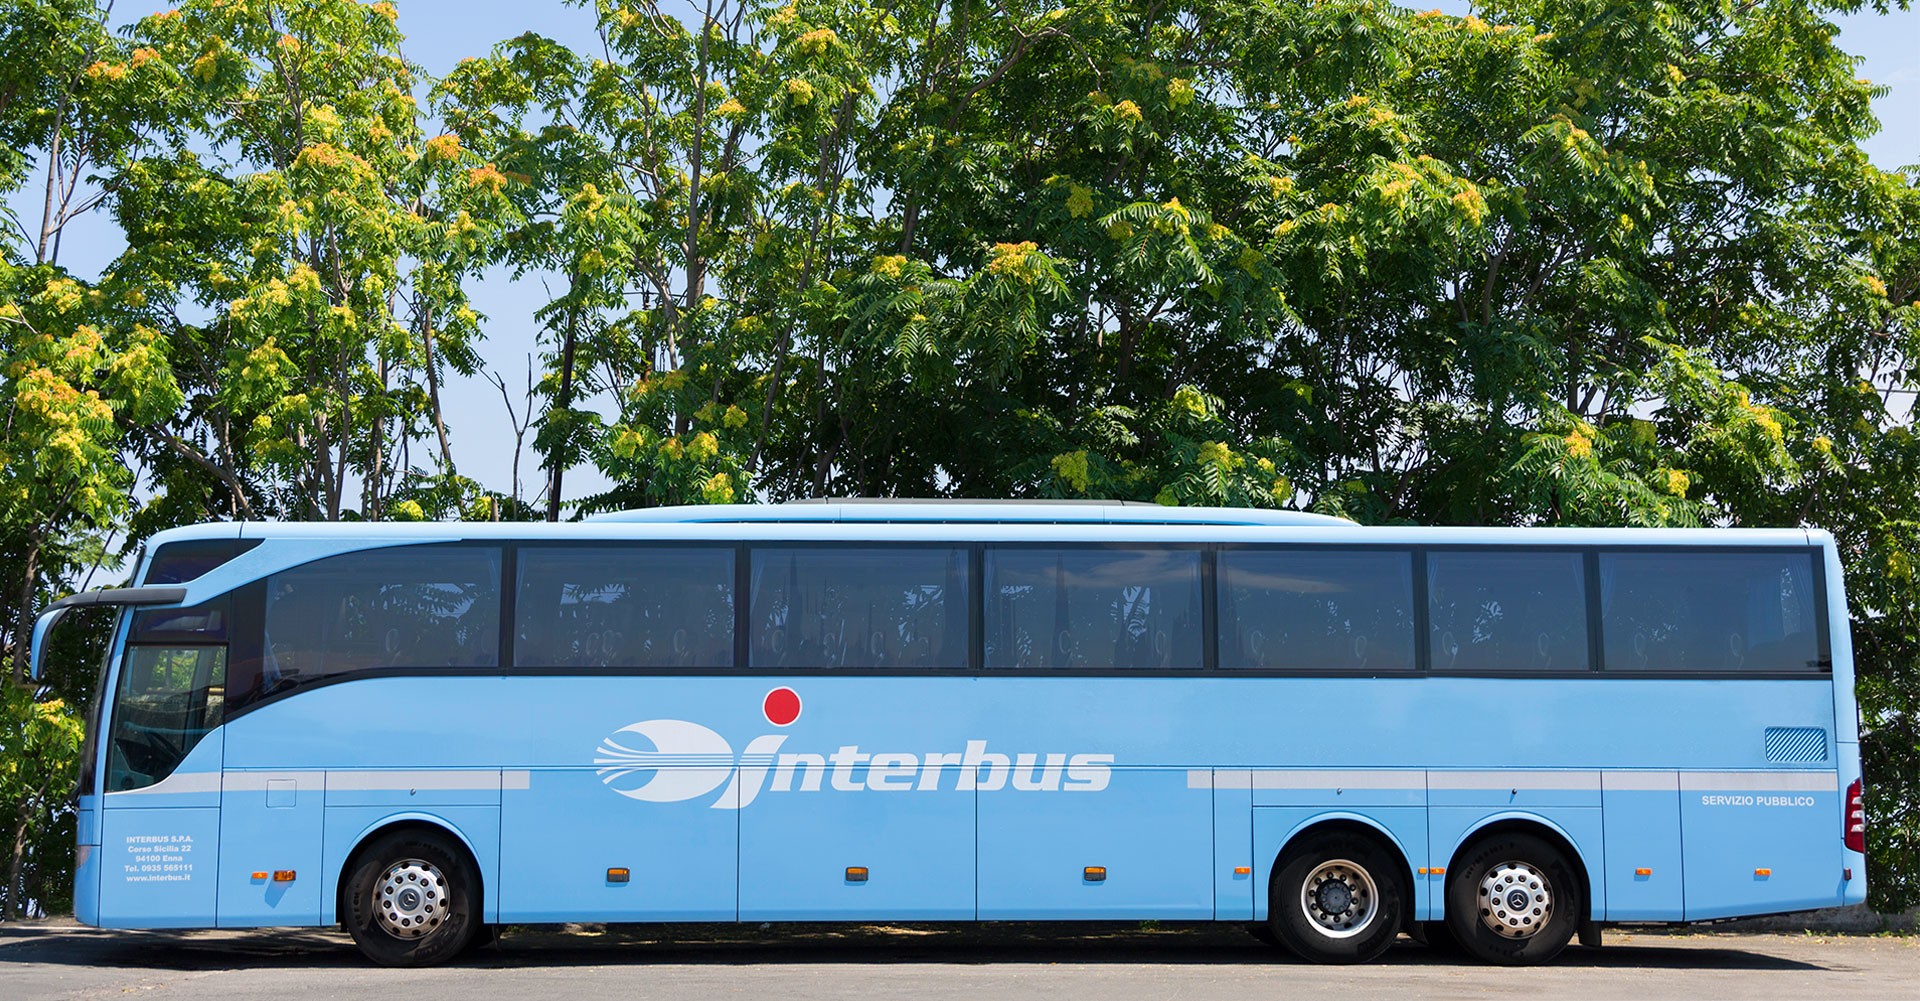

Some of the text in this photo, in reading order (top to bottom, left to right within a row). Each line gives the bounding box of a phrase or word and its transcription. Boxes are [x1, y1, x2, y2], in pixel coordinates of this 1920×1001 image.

[709, 687, 1115, 809] interbus
[1701, 795, 1815, 807] SERVIZIO PUBBLICO
[126, 873, 191, 882] www.interbus.it
